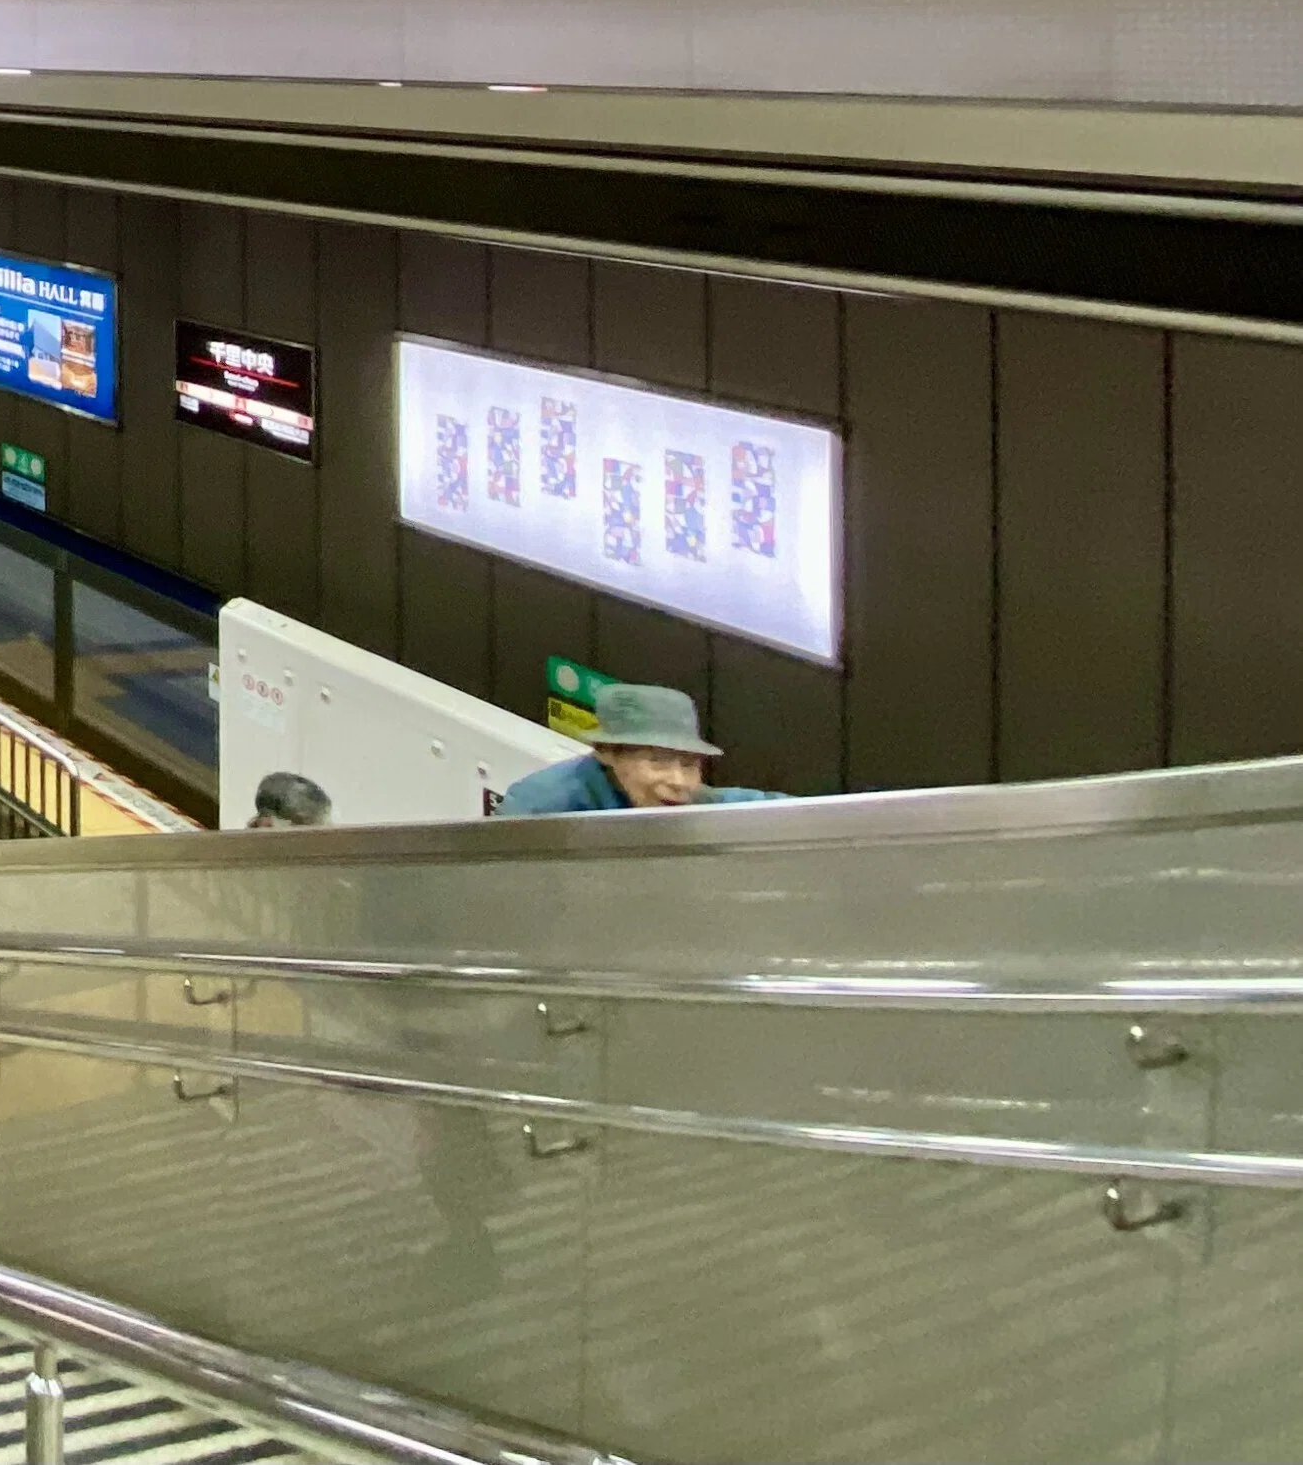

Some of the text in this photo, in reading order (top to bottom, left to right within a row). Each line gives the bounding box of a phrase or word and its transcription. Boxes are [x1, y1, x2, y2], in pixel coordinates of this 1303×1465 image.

[39, 280, 78, 304] HALL
[207, 341, 274, 376] 千里中央
